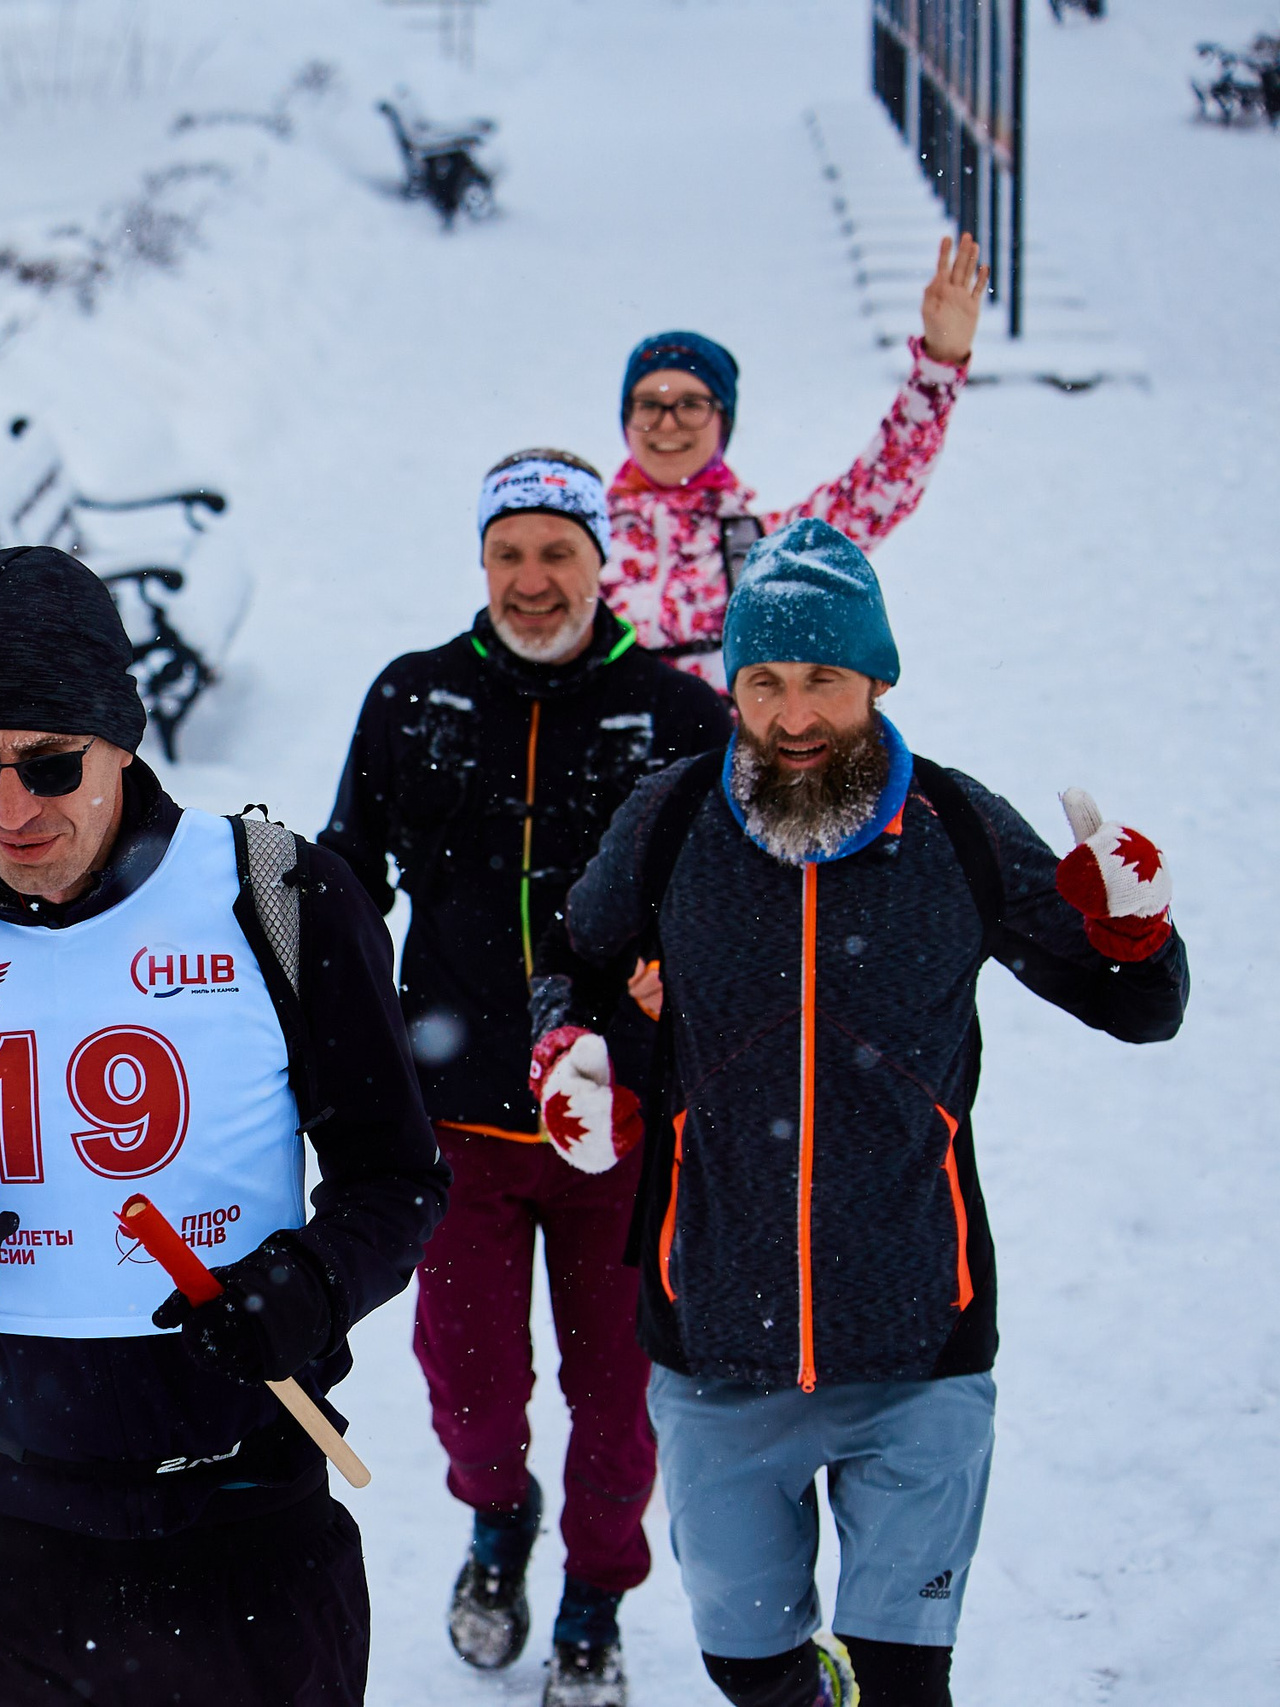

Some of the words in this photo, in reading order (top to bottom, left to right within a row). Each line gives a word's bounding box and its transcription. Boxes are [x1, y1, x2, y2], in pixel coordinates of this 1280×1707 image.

[148, 954, 235, 985] НЦВ
[181, 1204, 241, 1232] ППОО
[181, 1226, 227, 1248] НЦВ
